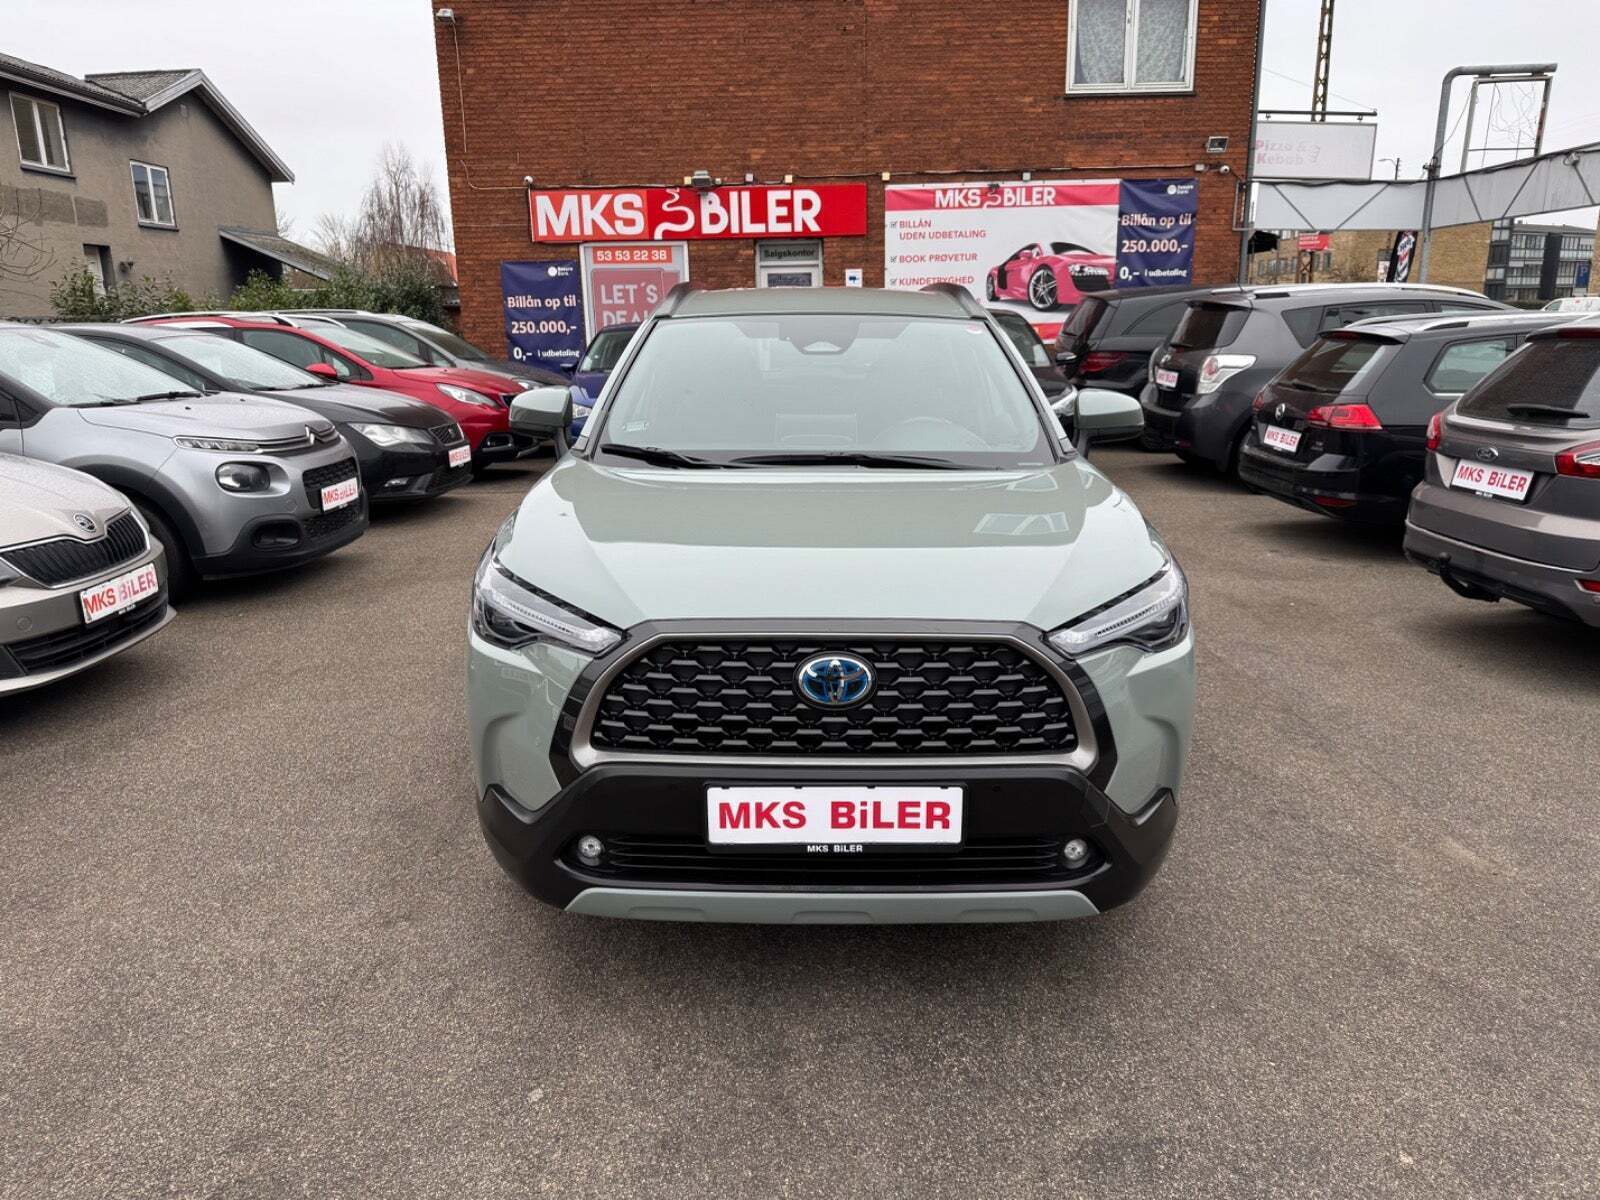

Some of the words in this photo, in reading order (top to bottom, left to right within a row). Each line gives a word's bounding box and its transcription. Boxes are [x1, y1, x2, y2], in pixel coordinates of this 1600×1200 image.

[935, 188, 981, 208] MKS
[1003, 187, 1056, 206] BILER
[535, 193, 645, 237] MKS
[700, 189, 822, 235] BILER
[899, 218, 932, 229] BILLÅN
[1121, 213, 1156, 226] Billån
[1159, 216, 1175, 229] op
[1178, 213, 1192, 225] til
[899, 231, 926, 240] UDEN
[928, 229, 987, 240] UDBETALING
[1121, 239, 1188, 254] 250.000,-
[596, 250, 612, 261] 53
[615, 250, 630, 261] 53
[633, 250, 649, 261] 22
[651, 249, 667, 261] 38
[899, 254, 926, 263] BOOK
[929, 253, 978, 263] PRØVETUR
[1148, 268, 1188, 278] udbetaling
[507, 294, 542, 308] Billån
[544, 298, 561, 310] op
[563, 294, 577, 307] til
[511, 320, 577, 335] 250.000,-
[541, 349, 580, 358] udbetaling
[1457, 465, 1485, 483] MKS
[1487, 471, 1528, 493] BiLER
[323, 487, 339, 505] MKS
[82, 587, 117, 614] MKS
[119, 571, 156, 601] BiLER
[718, 801, 807, 829] MKS
[830, 800, 951, 830] BiLER
[807, 844, 829, 853] MKS
[833, 844, 864, 853] BiLER
